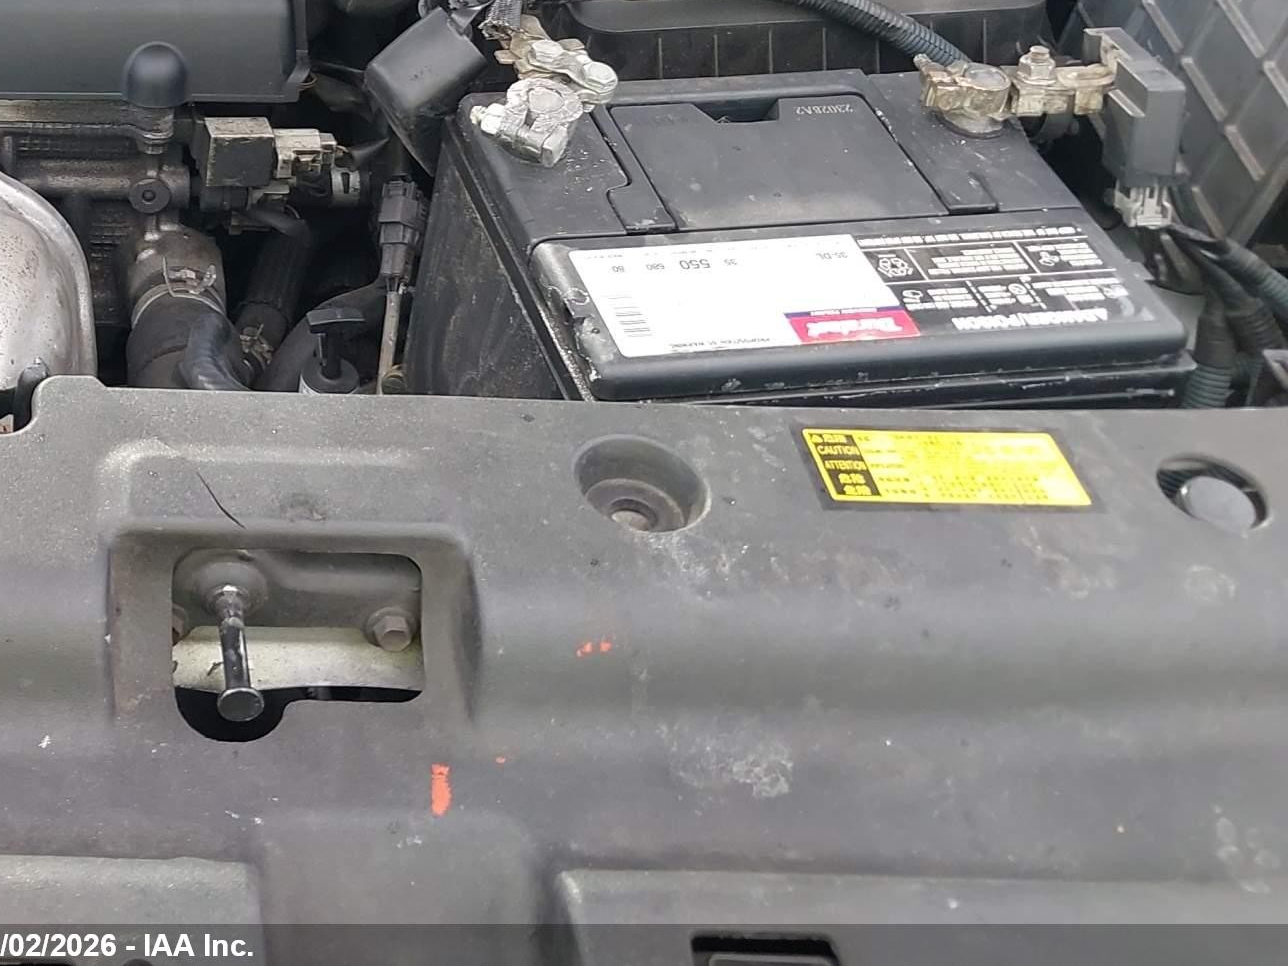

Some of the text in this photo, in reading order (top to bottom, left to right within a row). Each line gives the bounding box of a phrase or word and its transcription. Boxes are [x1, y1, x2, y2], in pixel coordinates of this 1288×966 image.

[679, 258, 711, 270] 550
[817, 445, 860, 455] CAUTION
[824, 460, 867, 470] ATTENTION
